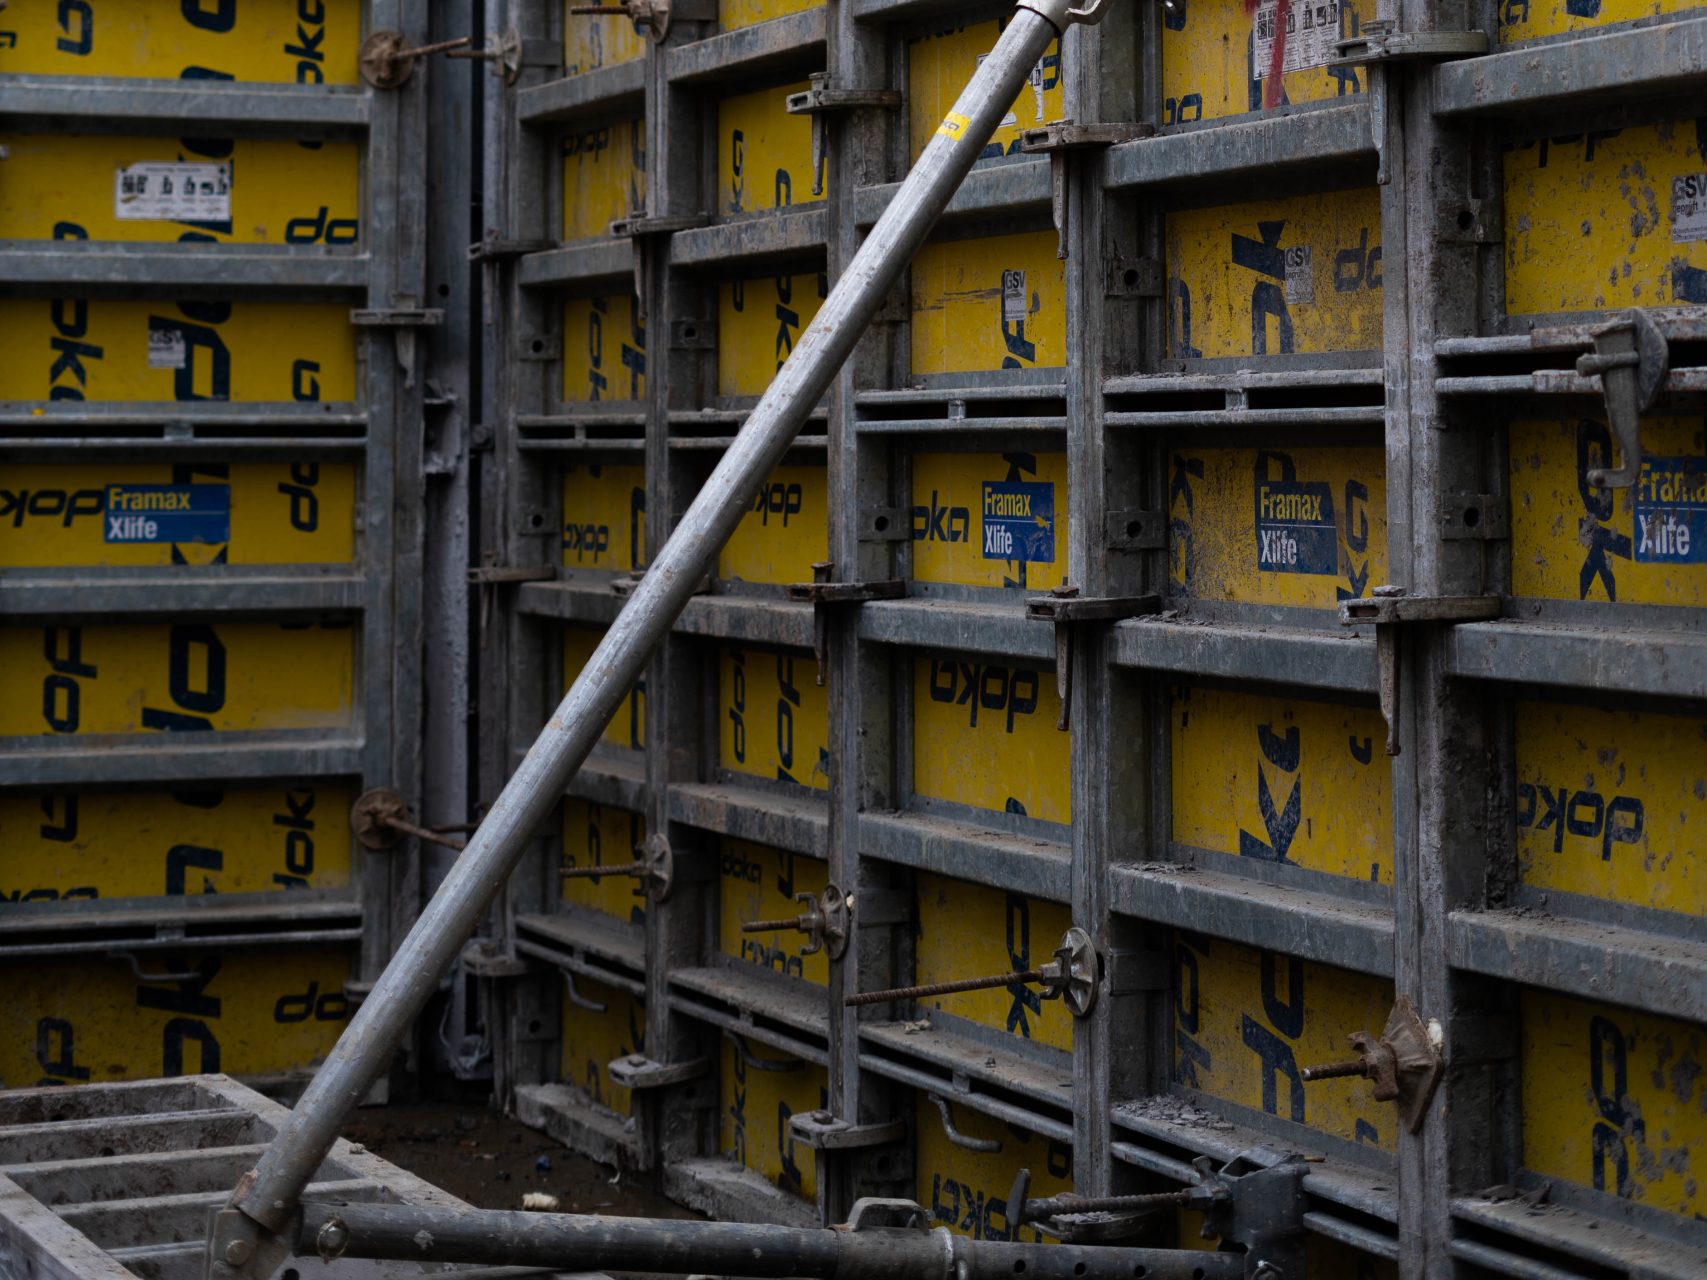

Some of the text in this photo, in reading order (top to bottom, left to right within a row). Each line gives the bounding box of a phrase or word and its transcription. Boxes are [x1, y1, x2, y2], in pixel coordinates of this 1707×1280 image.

[1006, 271, 1025, 290] GSV
[108, 487, 191, 510] Framax
[750, 483, 802, 527] dok
[984, 486, 1031, 518] Framax
[1260, 486, 1322, 521] Framax
[108, 516, 158, 540] Xlife
[911, 489, 969, 544] oka
[984, 524, 1012, 555] Xlife
[1260, 529, 1298, 565] Xlife
[930, 660, 1039, 733] doka
